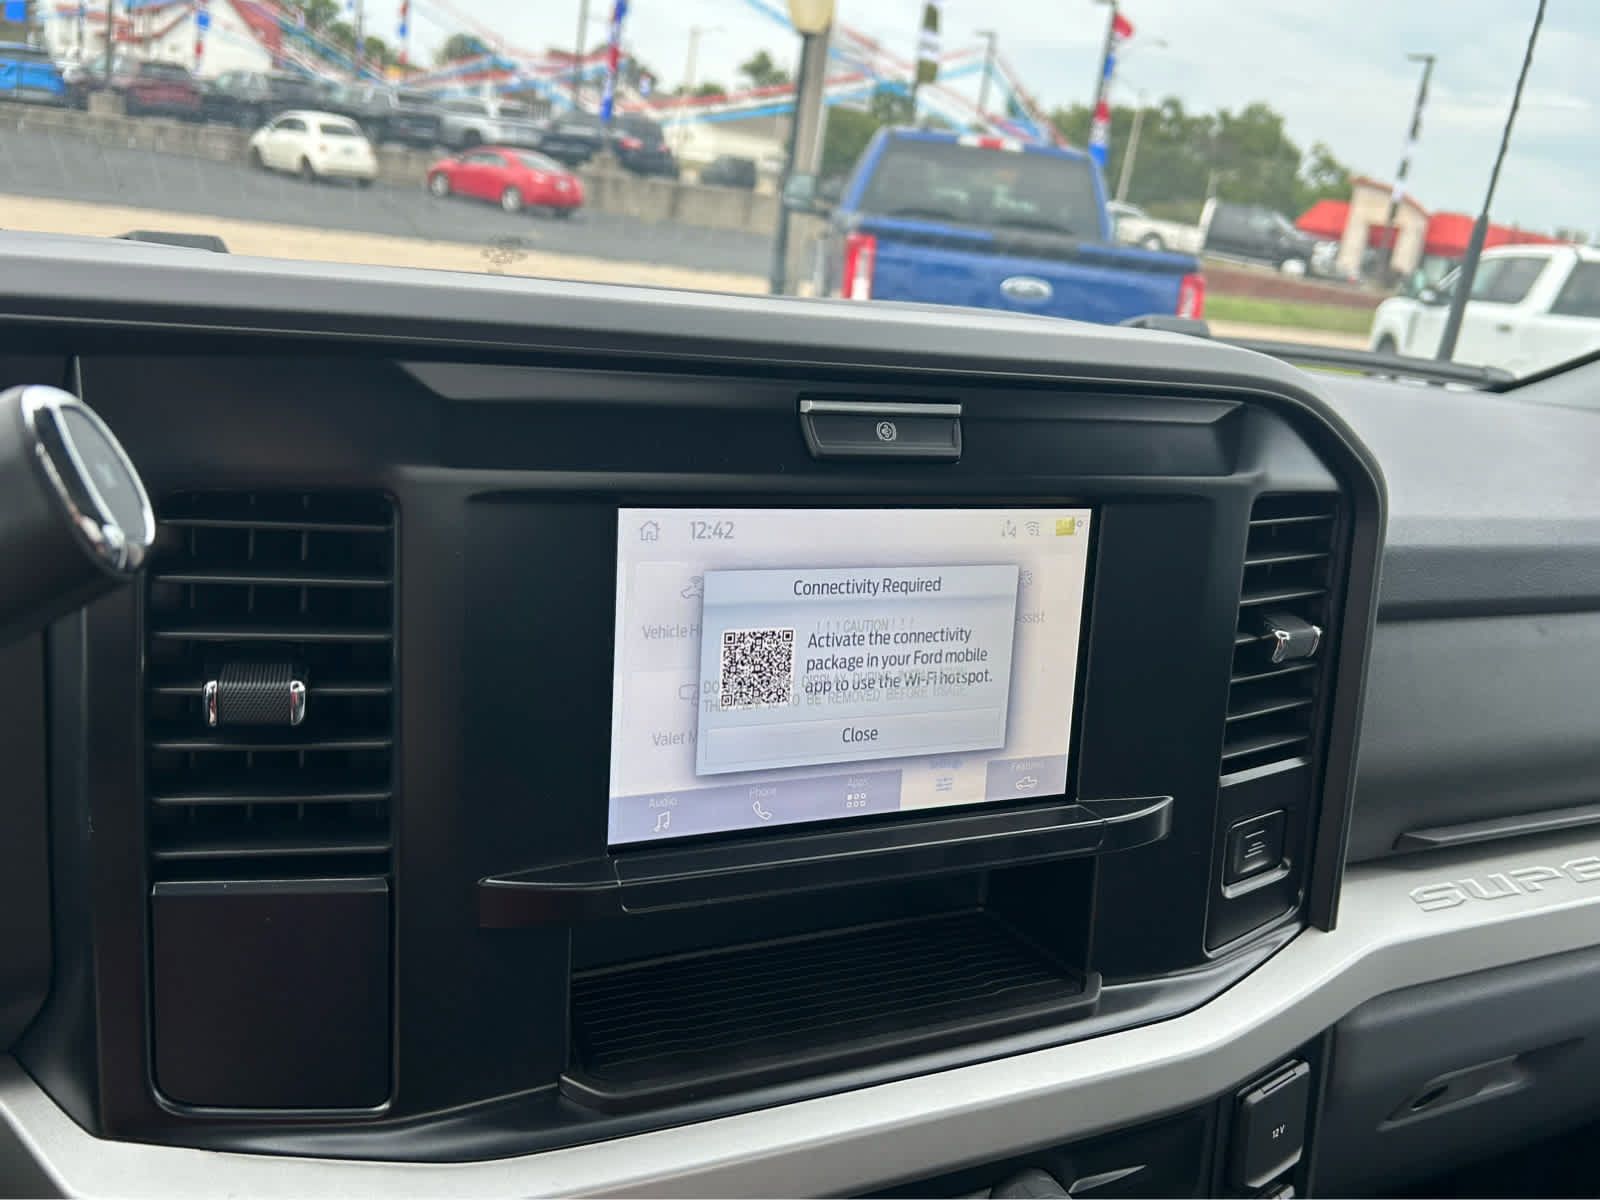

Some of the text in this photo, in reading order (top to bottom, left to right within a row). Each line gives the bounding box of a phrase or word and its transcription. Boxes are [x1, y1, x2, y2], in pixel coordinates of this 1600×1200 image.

[690, 521, 734, 540] 12:42
[793, 576, 942, 597] Connectivity Required
[843, 618, 888, 632] CAUTION
[1016, 610, 1046, 624] ssist
[641, 624, 687, 640] Vehicle
[807, 626, 972, 648] Activate the connectivity
[806, 653, 864, 674] package
[867, 652, 879, 667] in
[881, 654, 911, 669] your
[913, 649, 943, 665] Ford
[945, 647, 988, 664] mobile
[805, 679, 832, 695] app
[835, 677, 849, 691] to
[852, 676, 876, 690] use
[879, 672, 901, 689] the
[903, 671, 938, 687] Wi-Fi
[939, 668, 992, 686] hotspot.
[652, 733, 685, 747] Valet
[842, 727, 878, 743] Close
